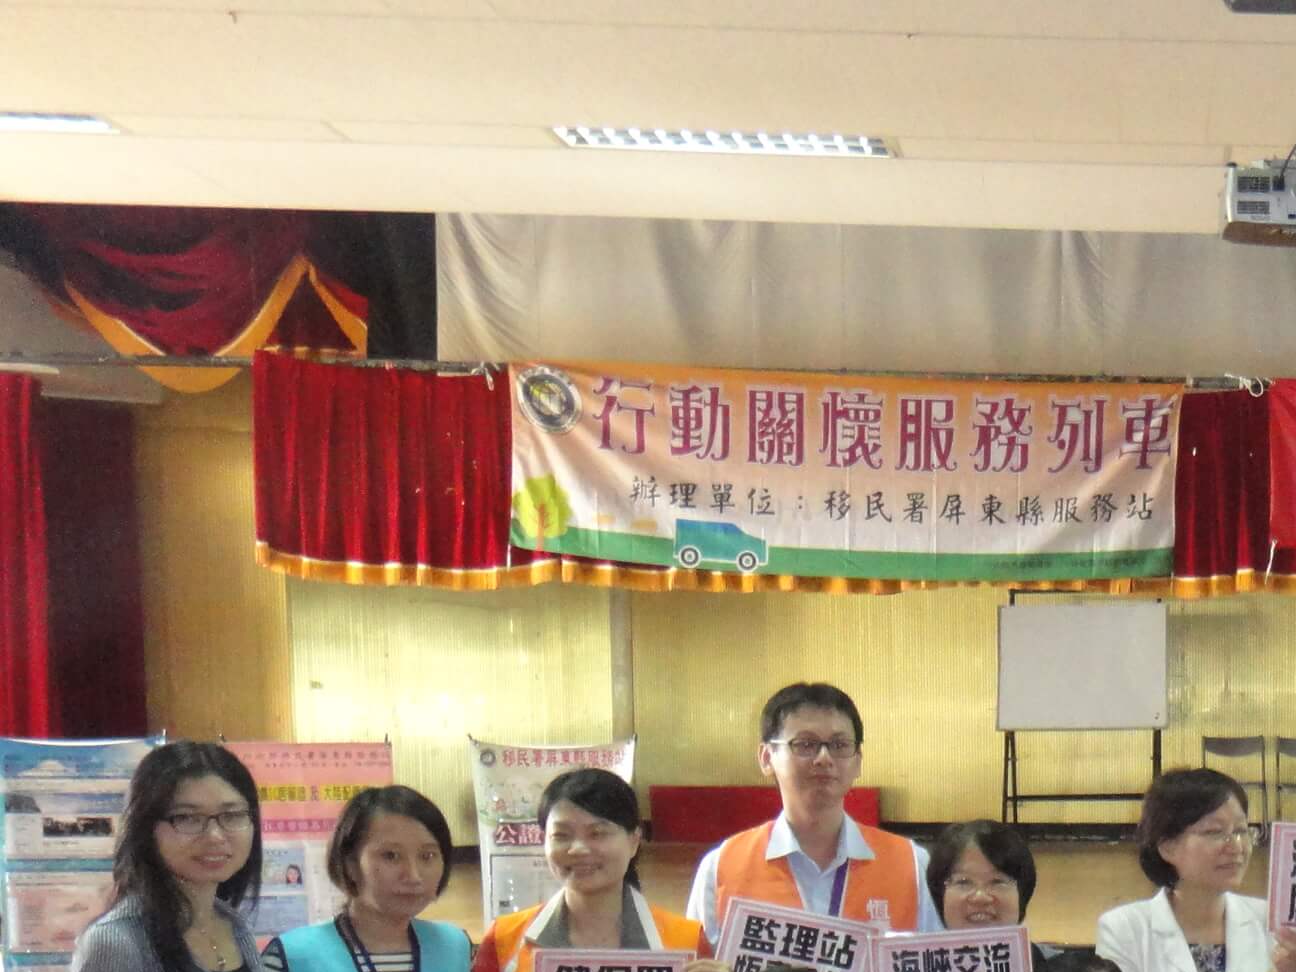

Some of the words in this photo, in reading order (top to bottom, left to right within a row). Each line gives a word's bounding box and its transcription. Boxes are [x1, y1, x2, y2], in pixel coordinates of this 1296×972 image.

[590, 376, 1175, 474] 行動關懷服務列車
[630, 475, 1155, 526] 辦理單位：移民署屏東縣服務站
[739, 914, 858, 970] 監理站
